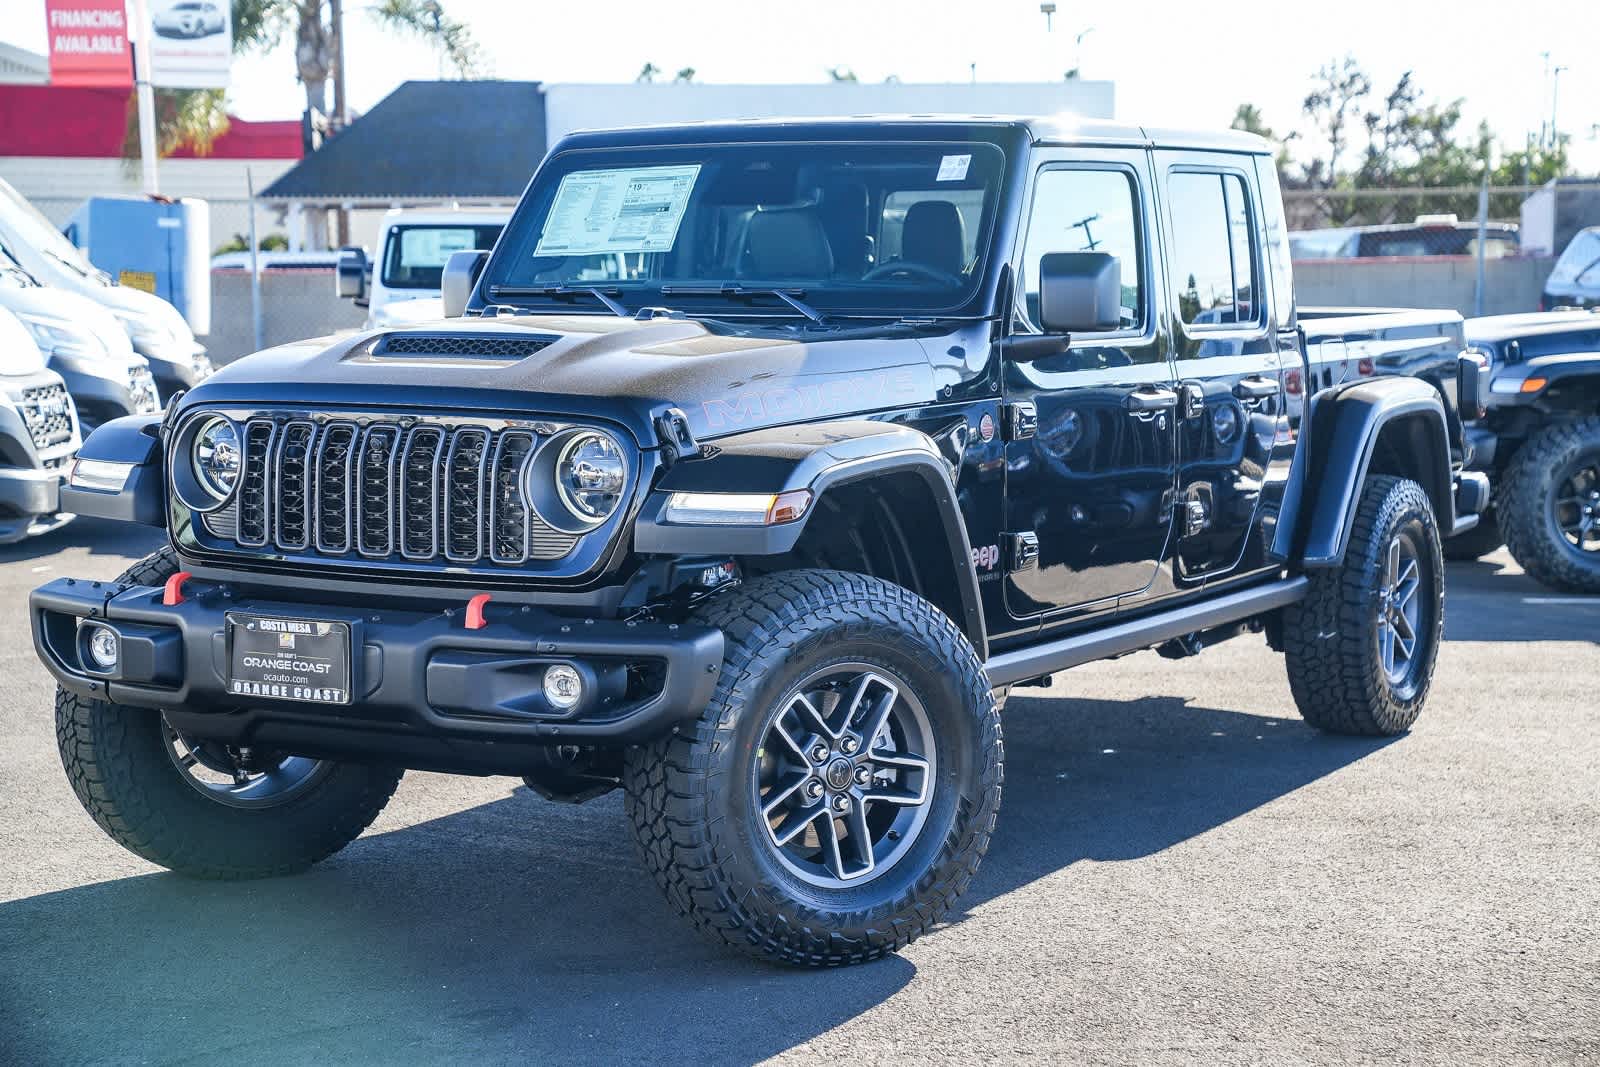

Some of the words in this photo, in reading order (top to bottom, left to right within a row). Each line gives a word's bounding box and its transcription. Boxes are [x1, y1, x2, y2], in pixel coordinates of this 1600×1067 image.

[51, 10, 122, 27] FINANCING
[55, 35, 124, 53] AVAILABLE
[972, 544, 999, 570] eep
[260, 620, 286, 631] COSTA
[288, 622, 311, 634] MESA
[243, 657, 291, 670] ORANGE
[293, 661, 331, 673] COAST
[263, 674, 308, 684] ocauto.com
[234, 682, 287, 697] ORANGE
[294, 687, 340, 701] COAST
